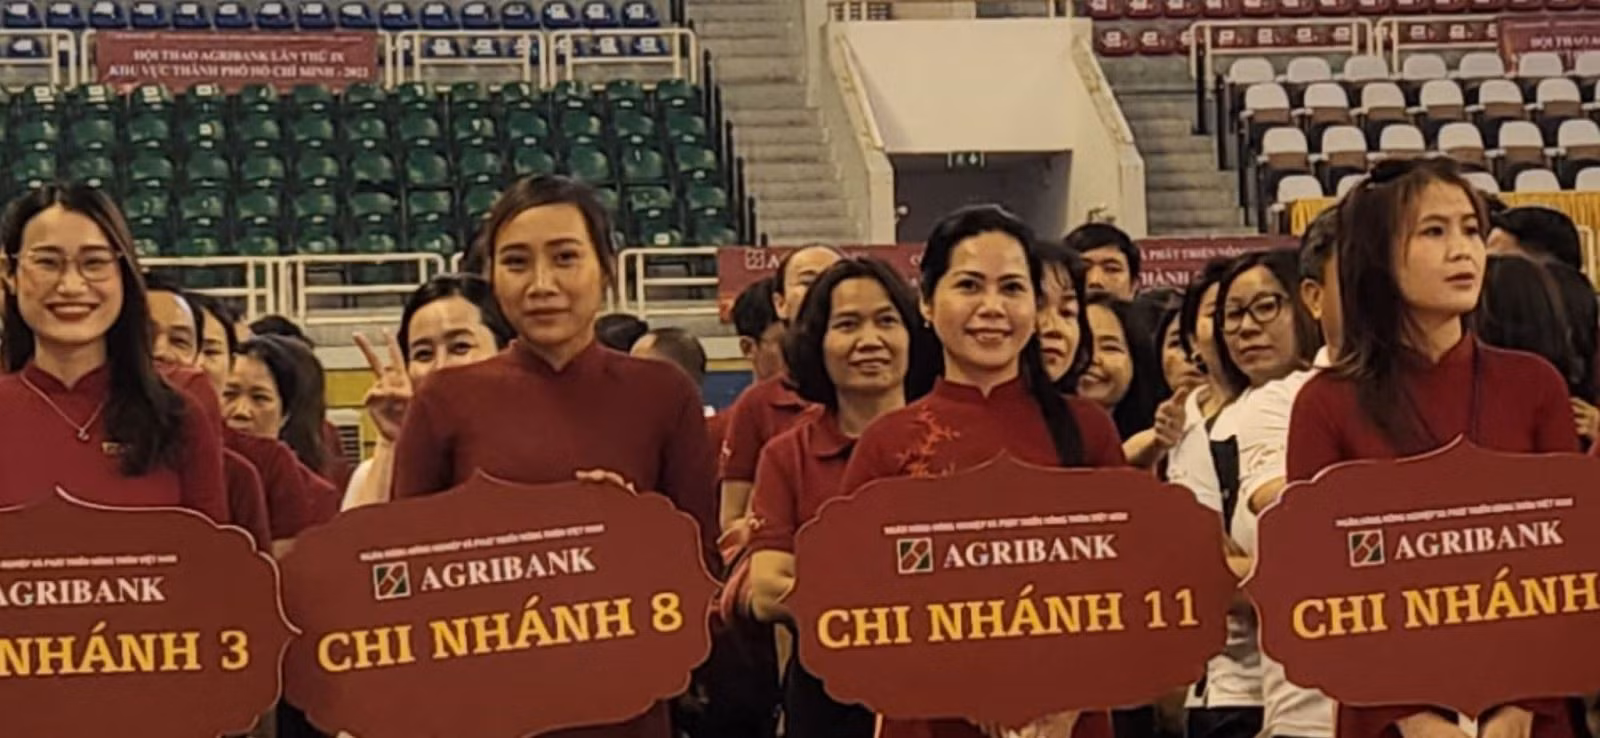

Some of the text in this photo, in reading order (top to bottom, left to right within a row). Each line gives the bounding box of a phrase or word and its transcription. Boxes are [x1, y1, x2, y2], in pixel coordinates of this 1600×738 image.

[109, 64, 138, 76] KHU
[299, 66, 336, 78] MINH
[133, 49, 159, 62] HỘI
[201, 50, 269, 62] AGRIBANK
[943, 534, 1118, 569] AGRIBANK
[1394, 520, 1563, 560] AGRIBANK
[420, 547, 595, 591] AGRIBANK
[817, 584, 1200, 649] CHI NHÁNH 11
[1292, 566, 1600, 639] CHI NHÁNH
[0, 621, 250, 676] NHÁNH 3
[318, 592, 683, 673] CHI NHÁNH 8
